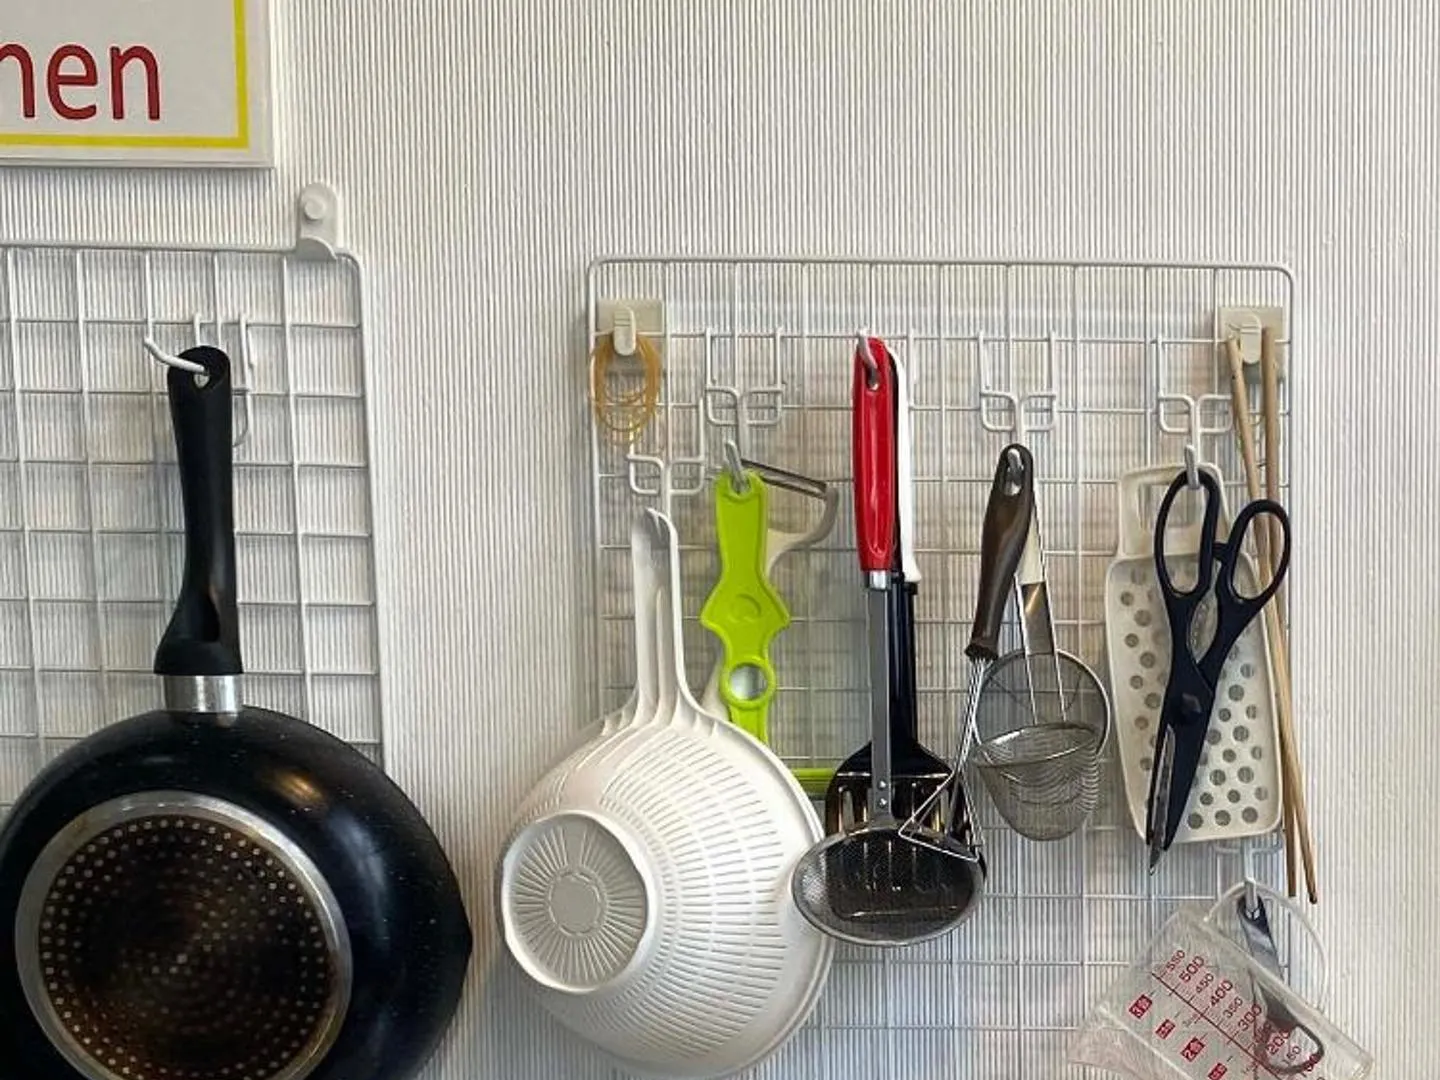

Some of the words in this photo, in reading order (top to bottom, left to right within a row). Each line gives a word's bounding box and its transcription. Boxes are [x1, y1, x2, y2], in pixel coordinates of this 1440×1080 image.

[1166, 949, 1186, 972] 550
[1179, 955, 1205, 983] 500
[1196, 973, 1214, 994] 450
[1210, 980, 1234, 1008] 400
[1223, 998, 1243, 1019] 350
[1238, 1004, 1263, 1032] 300
[1266, 1028, 1292, 1056] 200
